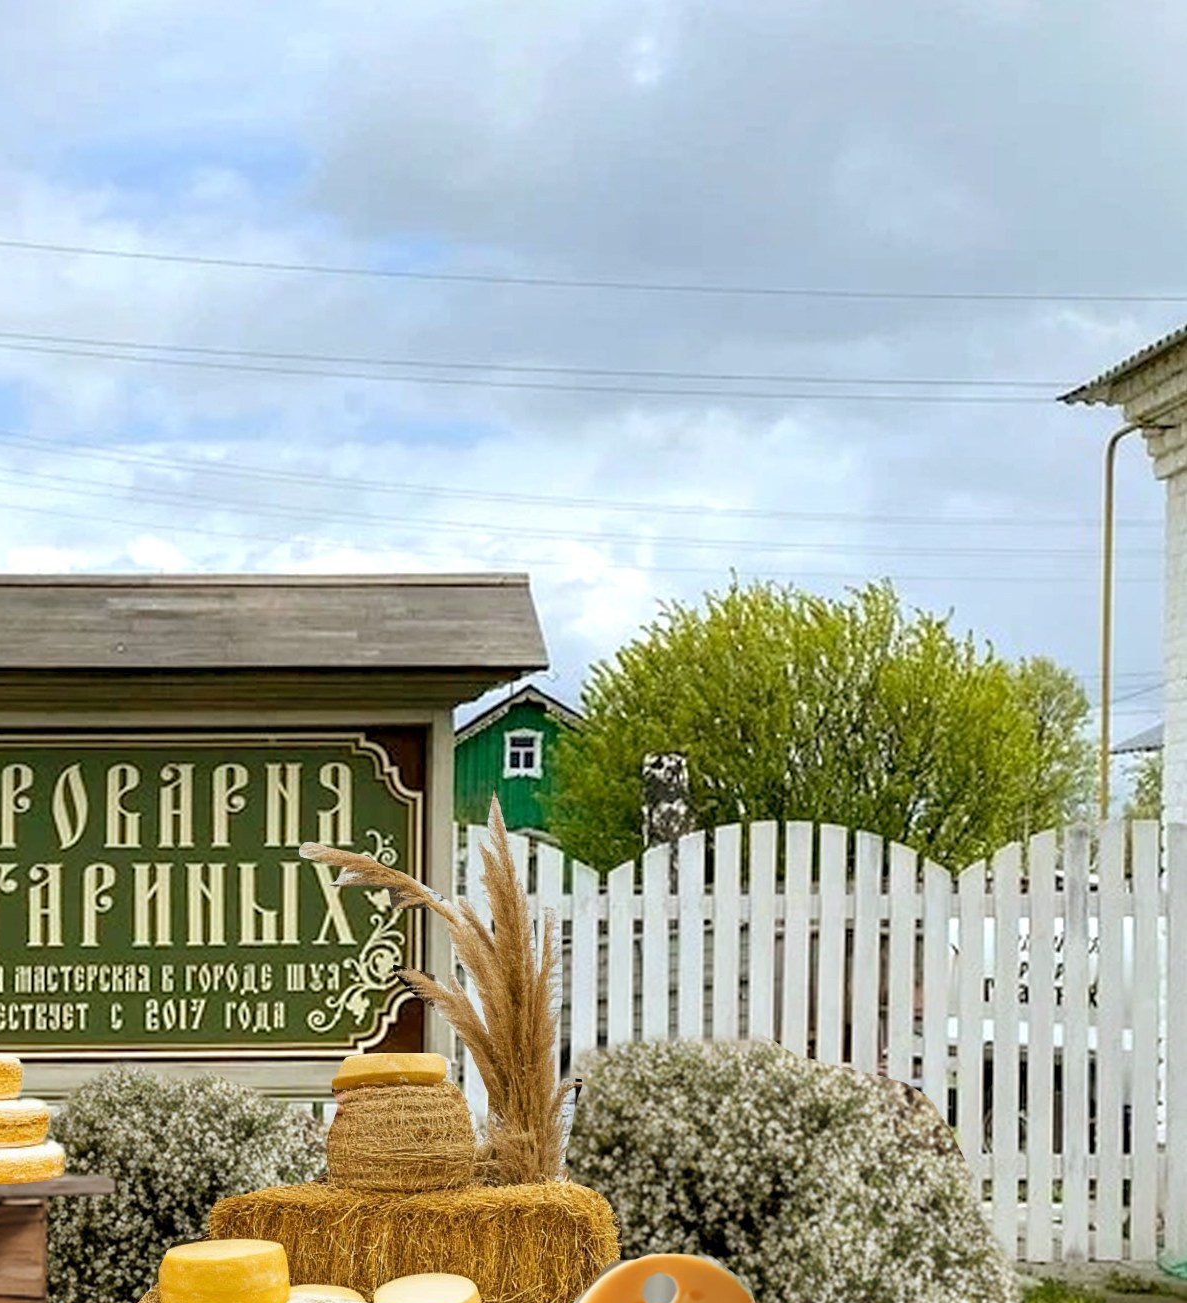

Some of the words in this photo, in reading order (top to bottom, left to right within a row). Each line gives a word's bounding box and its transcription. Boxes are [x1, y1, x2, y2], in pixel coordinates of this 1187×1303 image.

[14, 964, 151, 993] МАСТЕРСКАЯ
[161, 964, 175, 993] В
[185, 962, 273, 995] ГОРОДЕ
[286, 963, 341, 993] ШУЯ
[110, 1002, 123, 1031] С
[145, 998, 207, 1031] 2017
[224, 1001, 286, 1033] ГОДА
